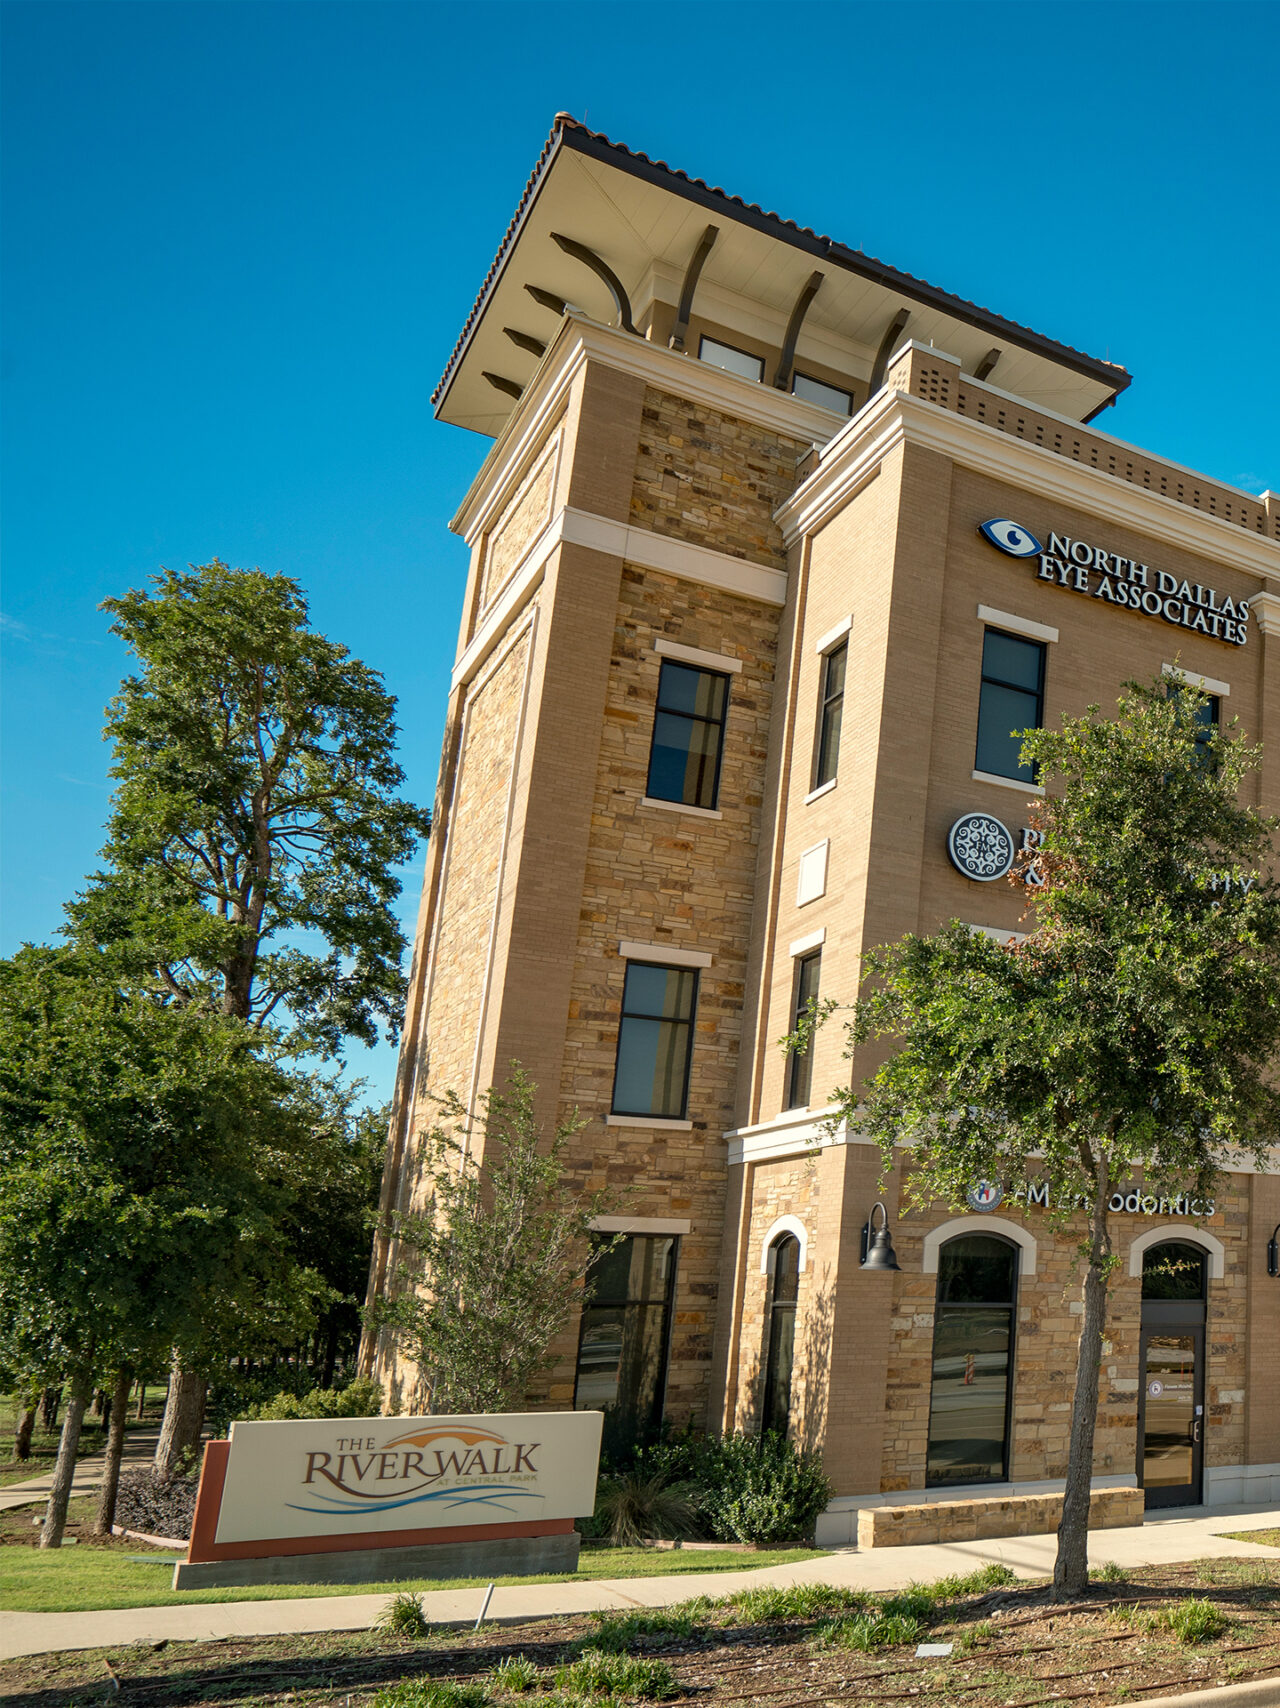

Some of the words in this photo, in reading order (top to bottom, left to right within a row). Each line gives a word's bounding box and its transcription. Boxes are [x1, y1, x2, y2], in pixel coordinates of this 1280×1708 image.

[1048, 531, 1149, 587] NORTH
[1156, 570, 1249, 622] DALLAS
[1039, 553, 1089, 592] EYE
[1095, 576, 1248, 645] ASSOCIATES
[1057, 1187, 1216, 1217] nodontics
[336, 1437, 376, 1451] THE
[436, 1478, 451, 1486] AT
[455, 1476, 504, 1485] CENTRAL
[510, 1474, 538, 1483] PARK
